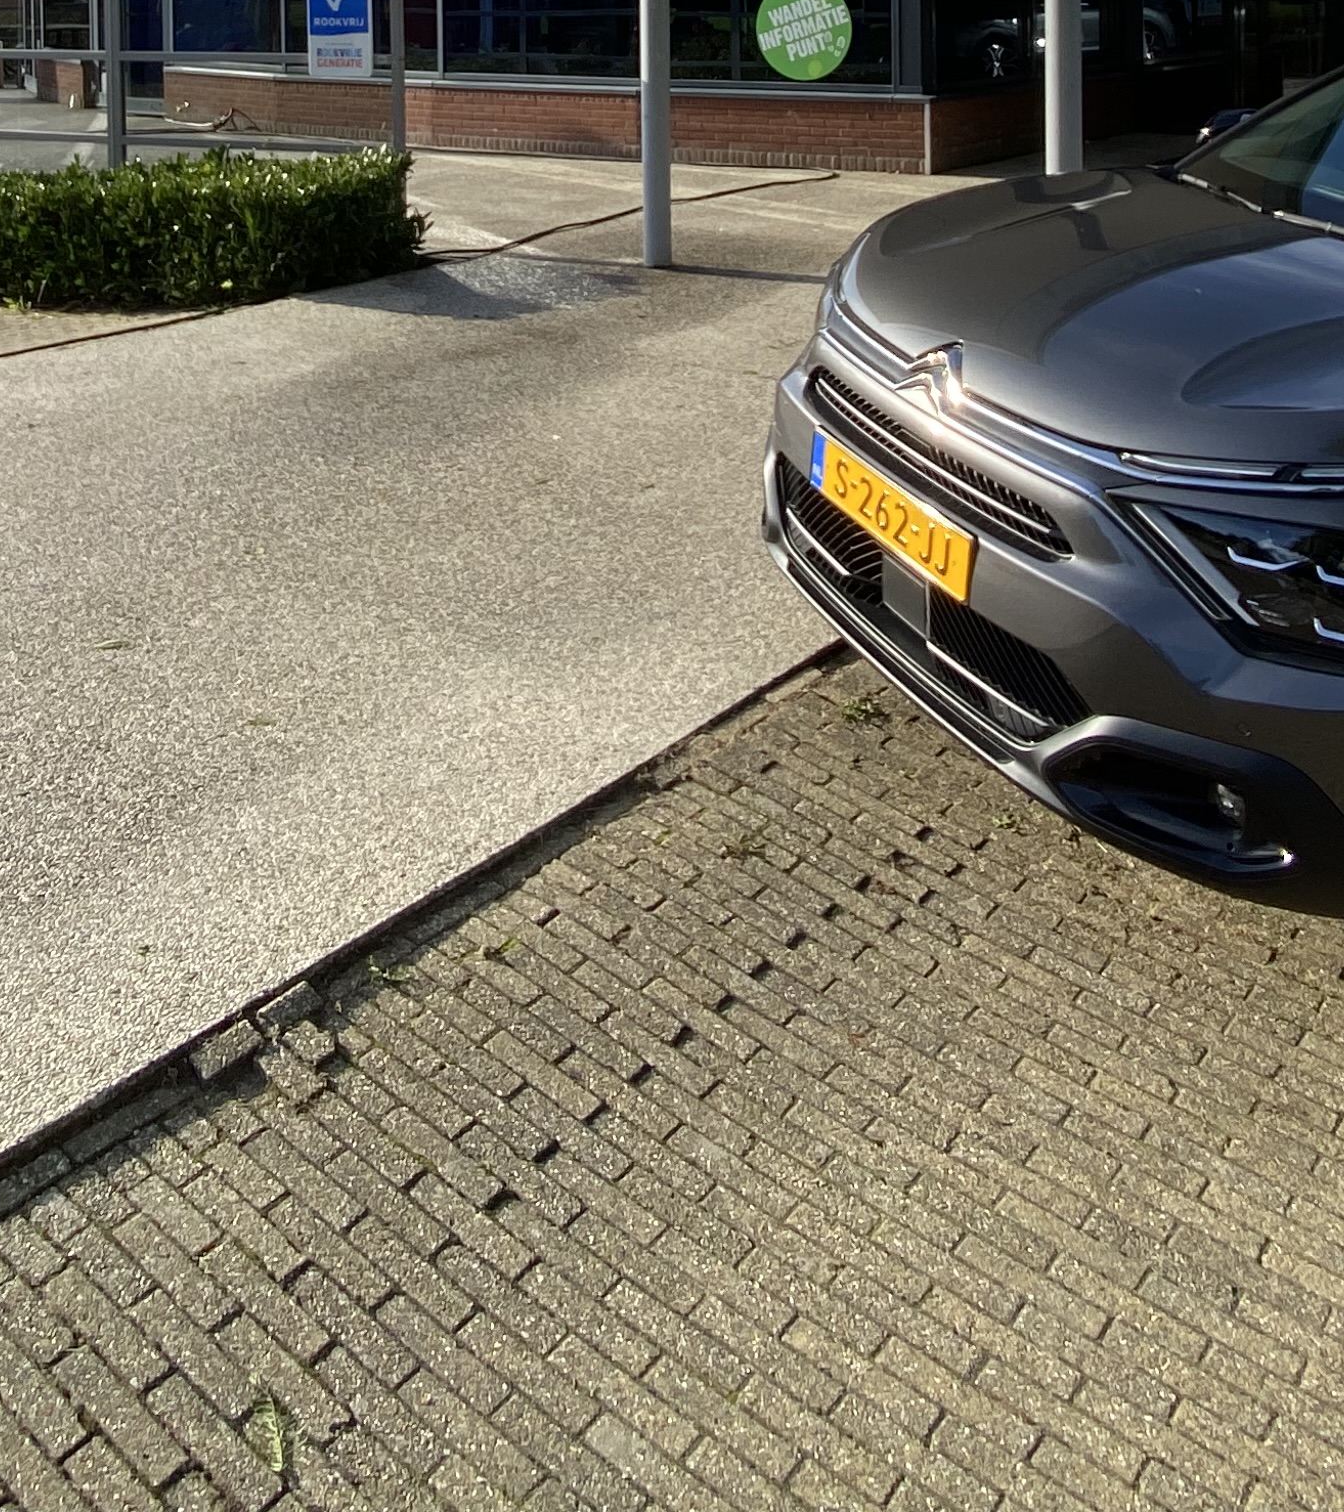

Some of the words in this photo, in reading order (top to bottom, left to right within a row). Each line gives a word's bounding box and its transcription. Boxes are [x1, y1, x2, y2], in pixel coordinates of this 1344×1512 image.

[314, 17, 364, 26] ROOKVRIJ
[759, 5, 849, 51] INFORMATIE
[786, 33, 826, 62] PUNT
[317, 58, 362, 68] GENERATIE
[834, 458, 951, 576] S-262-JJ
